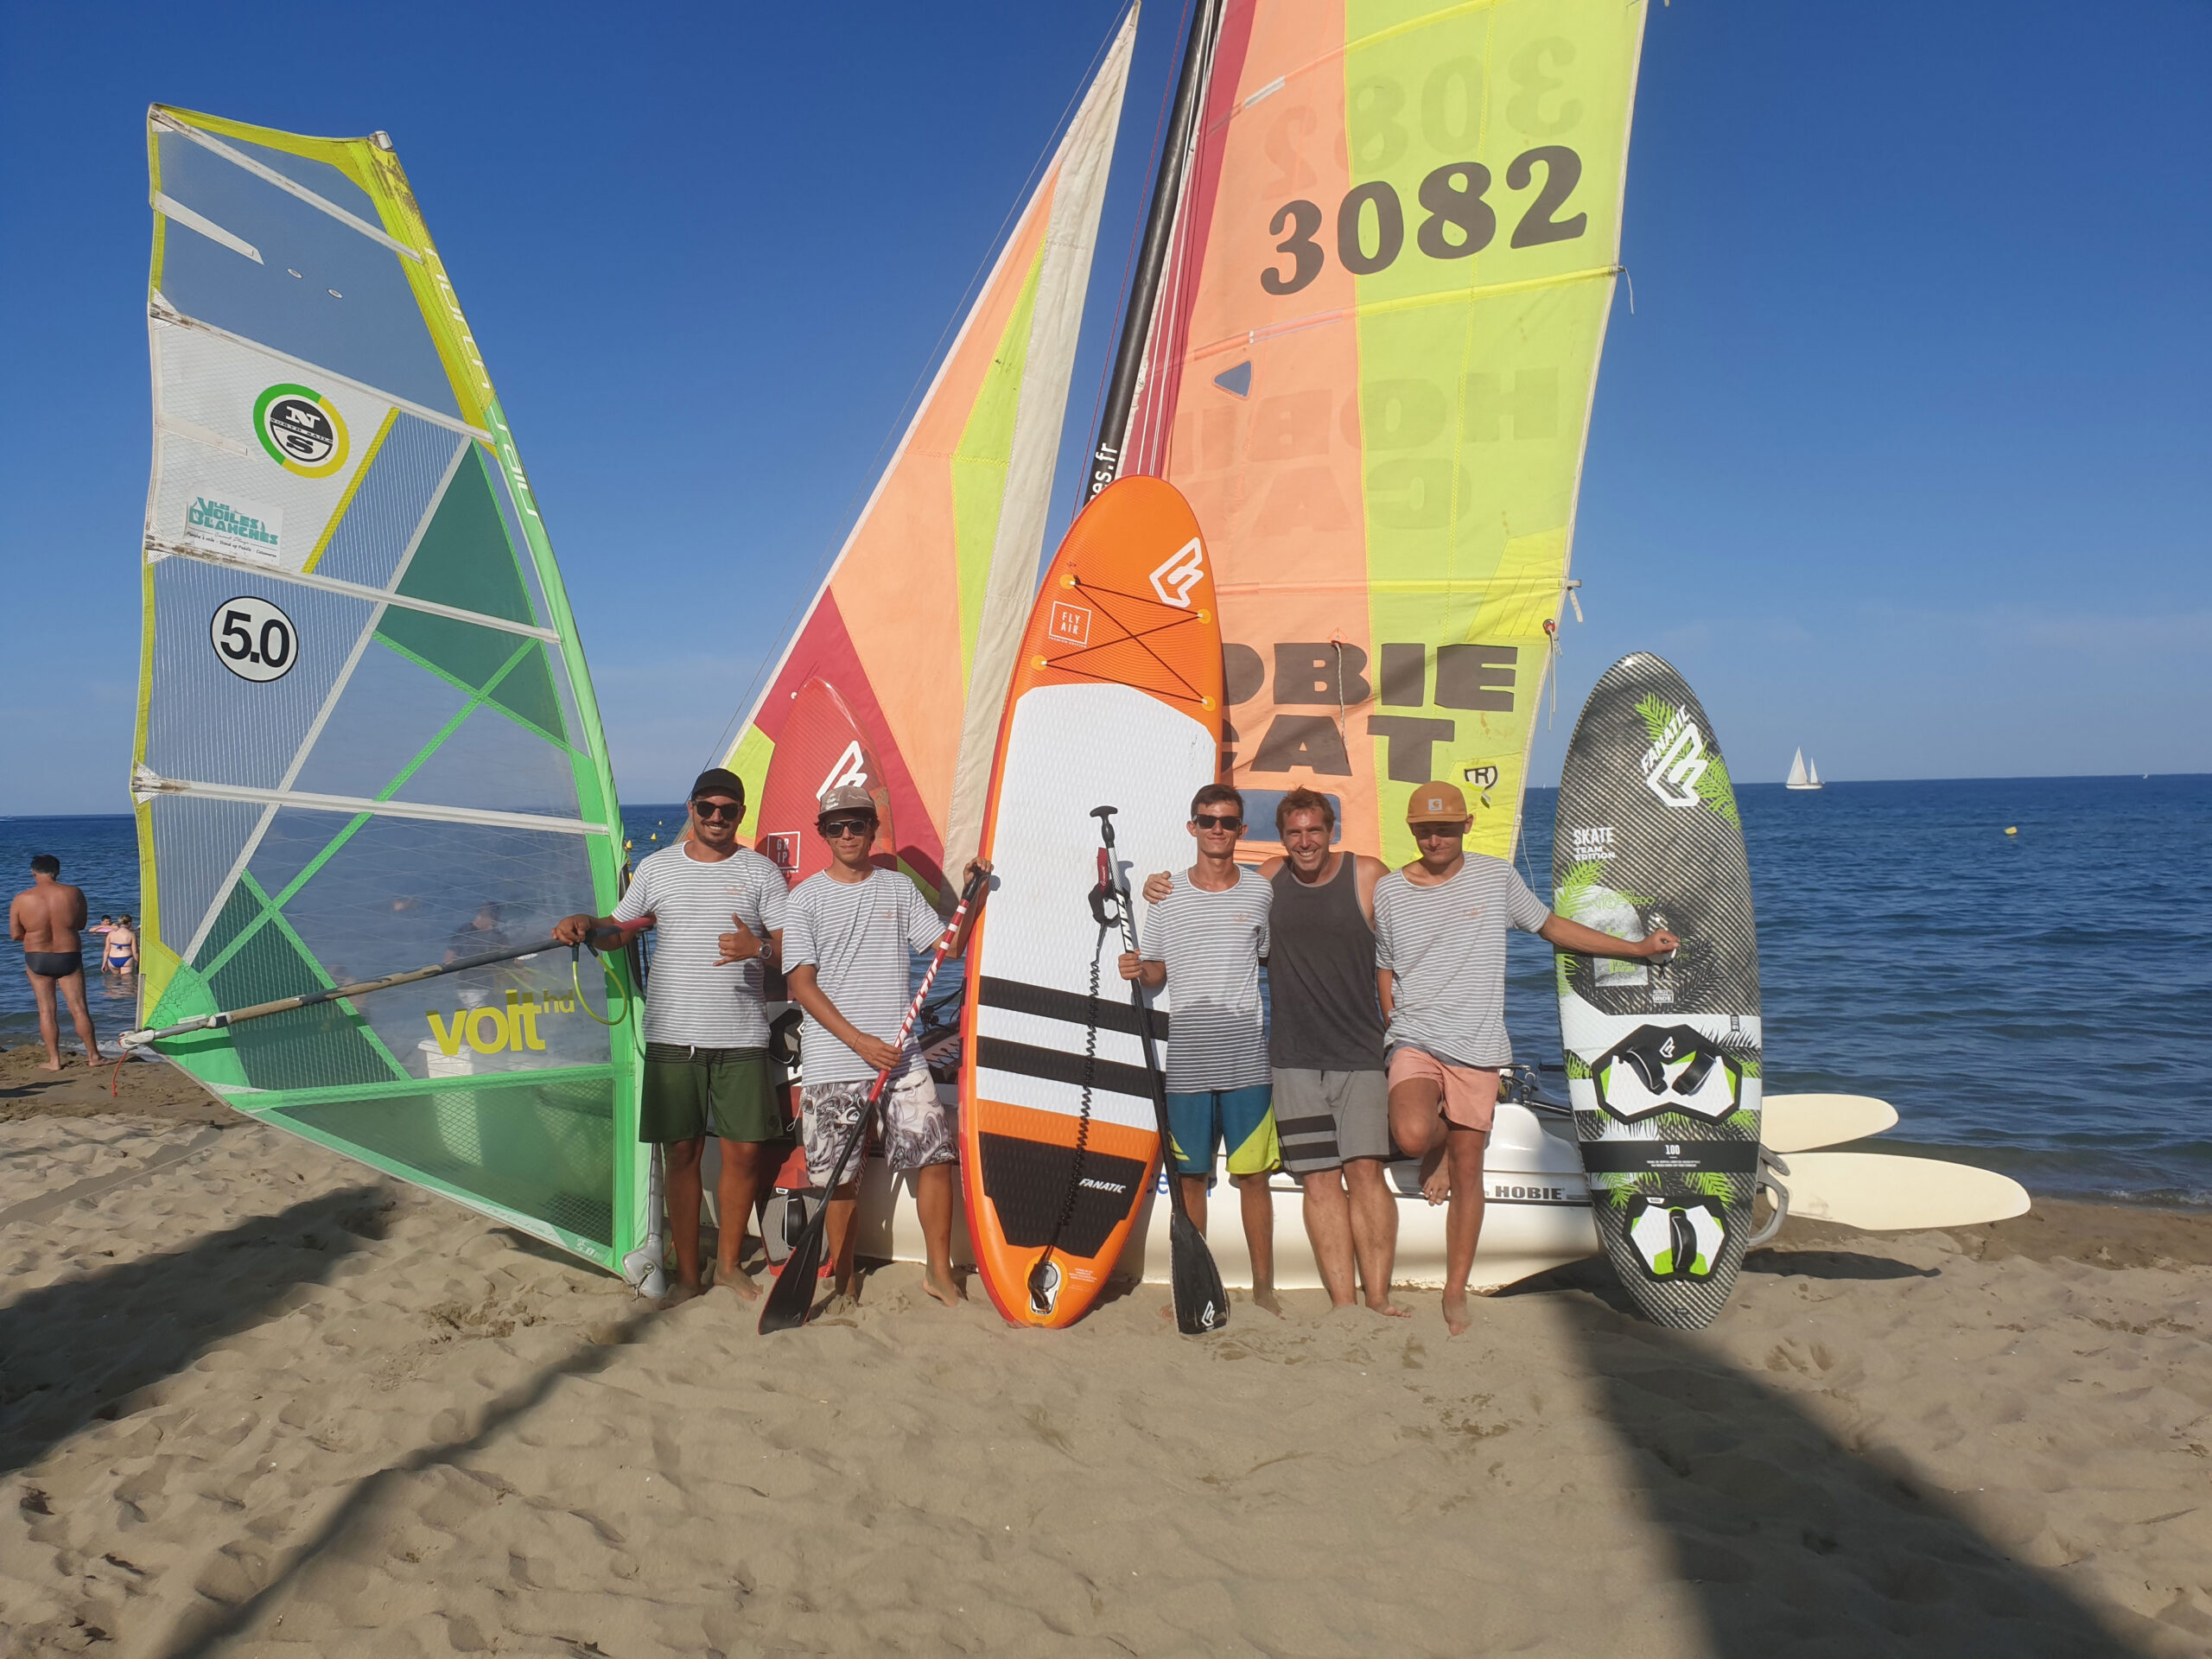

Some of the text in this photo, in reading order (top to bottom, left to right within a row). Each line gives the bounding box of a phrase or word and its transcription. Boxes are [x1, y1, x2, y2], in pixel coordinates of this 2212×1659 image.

[1260, 145, 1588, 296] 3082
[1090, 442, 1118, 501] es.fr
[1061, 612, 1081, 625] FLY
[1060, 621, 1079, 635] AIR
[219, 609, 290, 669] 5.0
[1641, 704, 1691, 775] FANATIC
[1221, 714, 1455, 785] AT
[1573, 827, 1614, 846] SKATE
[1574, 845, 1604, 855] TEAM
[1574, 851, 1617, 861] EDITION
[425, 988, 575, 1057] volt hd
[1665, 1144, 1681, 1155] 100
[1078, 1177, 1127, 1194] FANATIC
[1495, 1185, 1562, 1200] HOBIE
